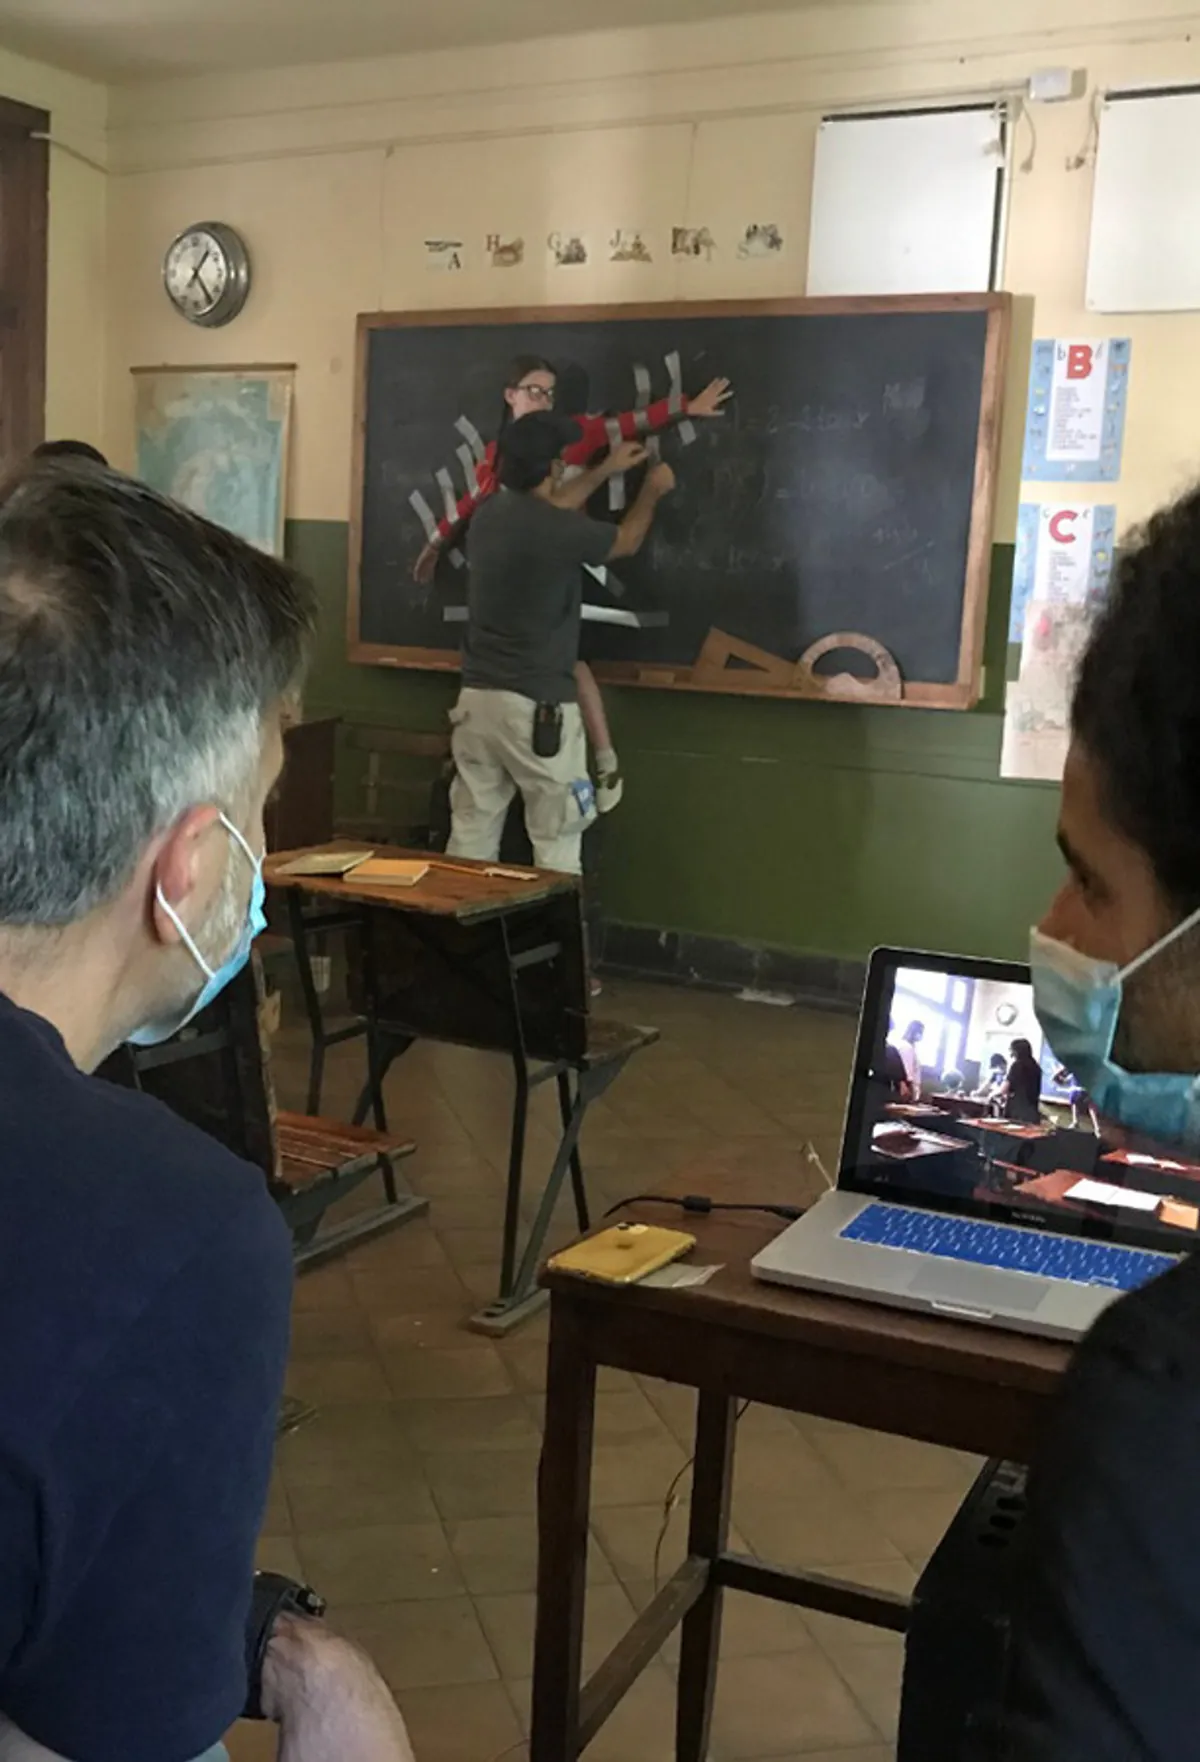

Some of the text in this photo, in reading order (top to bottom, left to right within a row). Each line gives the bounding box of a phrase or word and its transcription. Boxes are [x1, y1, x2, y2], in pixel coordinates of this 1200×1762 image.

[486, 233, 500, 252] H
[448, 252, 461, 270] A
[1066, 344, 1093, 379] B
[1049, 509, 1078, 544] C
